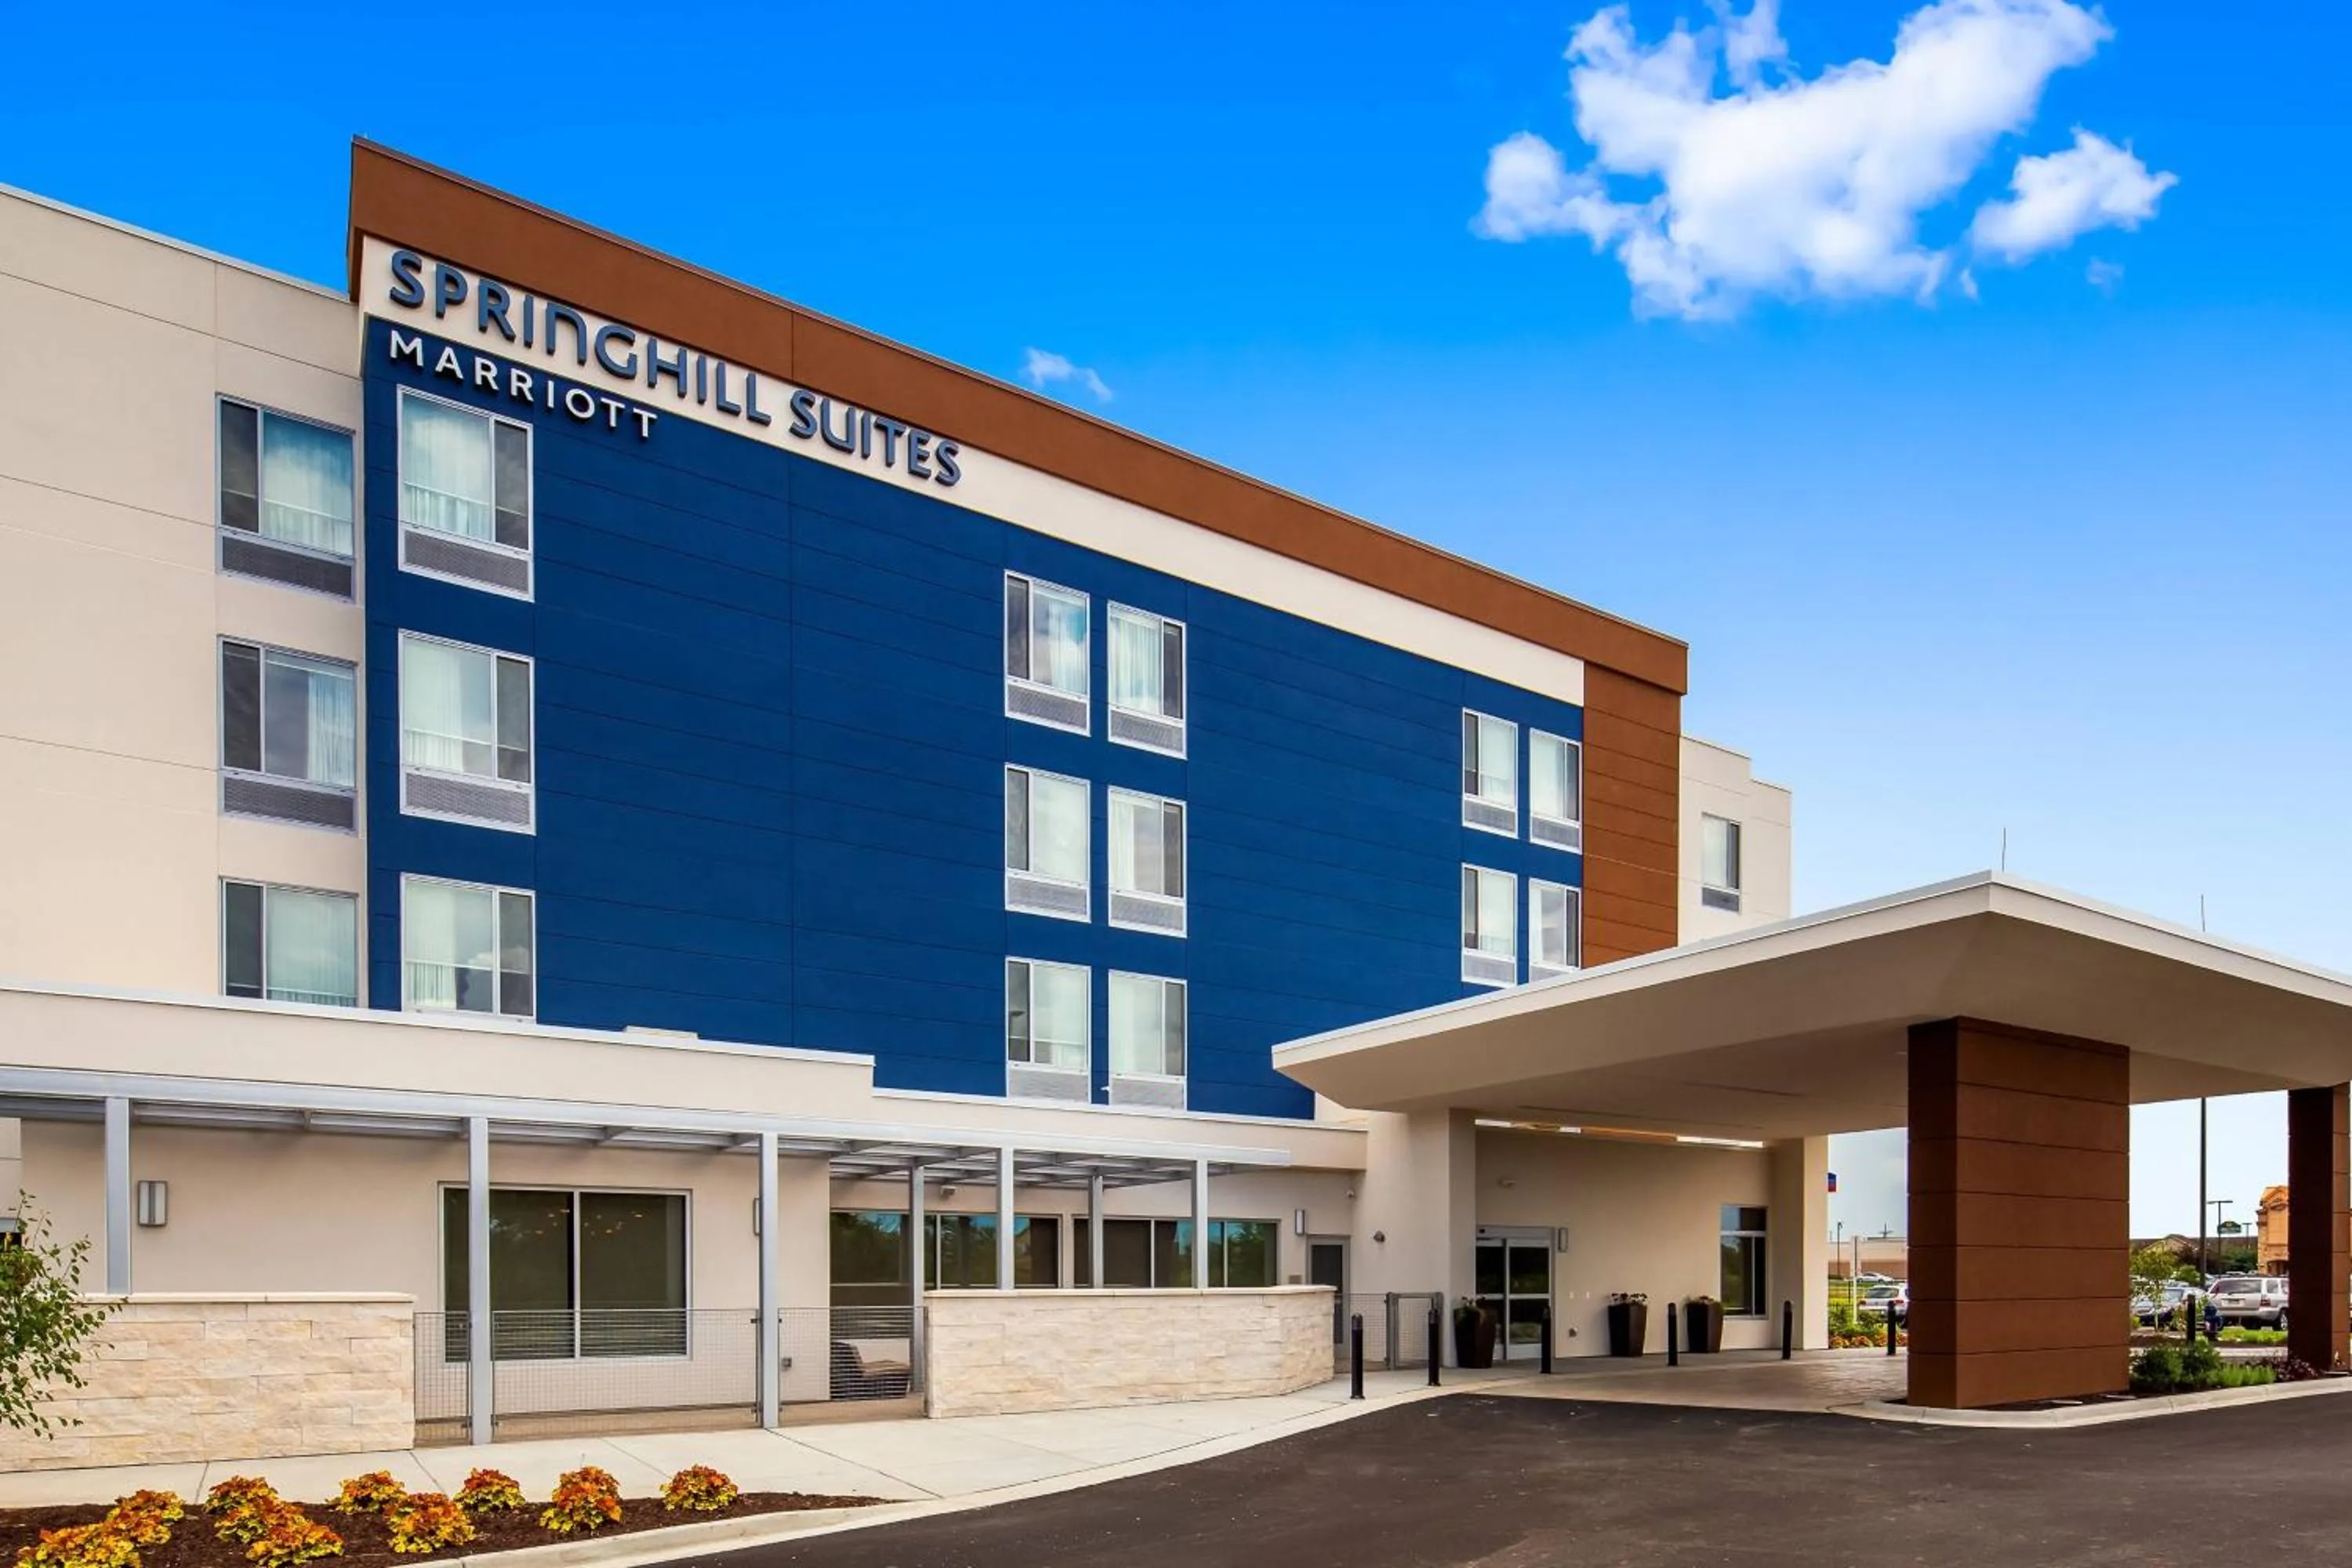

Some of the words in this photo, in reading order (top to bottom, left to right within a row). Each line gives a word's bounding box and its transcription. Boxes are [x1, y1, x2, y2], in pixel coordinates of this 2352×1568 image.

[390, 249, 772, 426] SPRINGHILL
[789, 389, 962, 487] SUITES
[390, 330, 658, 438] MARRIOTT
